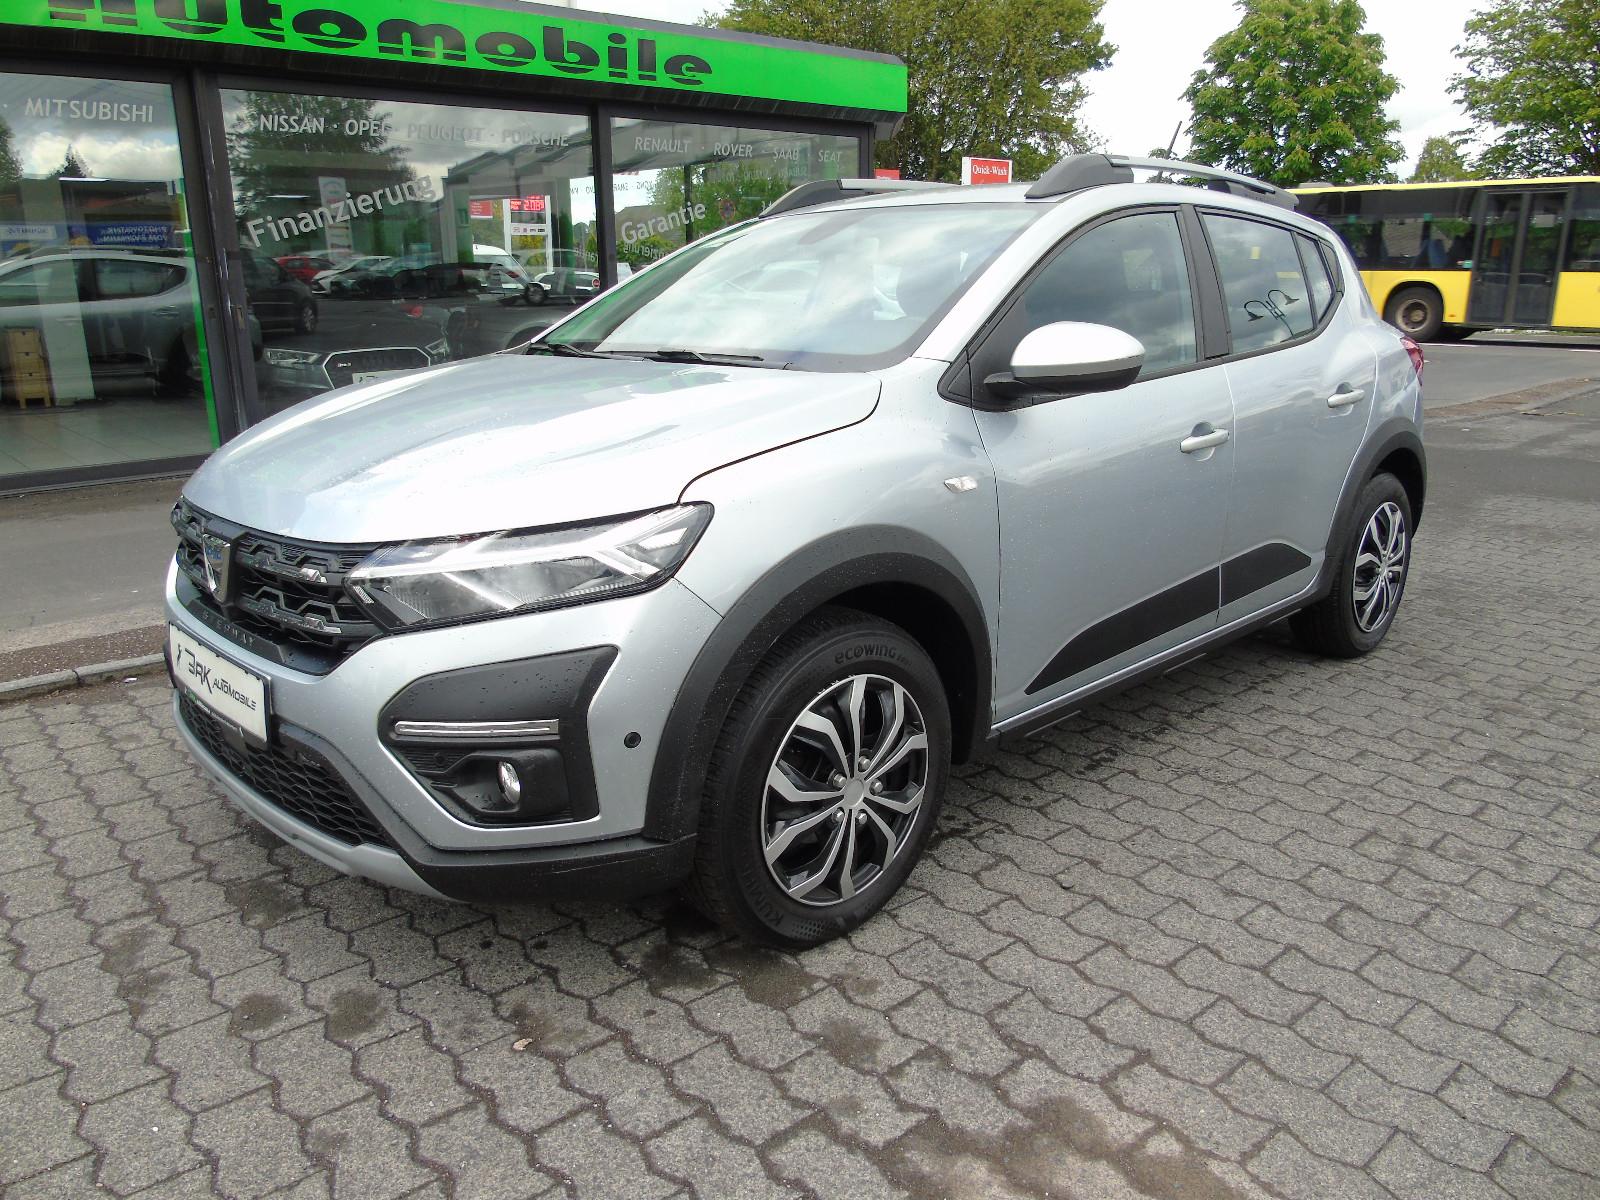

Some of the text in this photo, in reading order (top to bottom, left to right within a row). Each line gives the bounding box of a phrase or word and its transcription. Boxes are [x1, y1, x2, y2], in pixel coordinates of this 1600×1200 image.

[25, 98, 153, 123] MITSUBISHI
[259, 114, 325, 134] NISSAN
[407, 123, 486, 142] PEUGEOT
[502, 129, 569, 147] PORSCHE
[635, 136, 842, 162] RENAULT ROVER SAAB SEAT
[972, 164, 1008, 177] Quick-Wash
[246, 175, 437, 248] Finanzierung
[621, 201, 706, 244] Garantie
[212, 677, 257, 711] AUTOMOBILE
